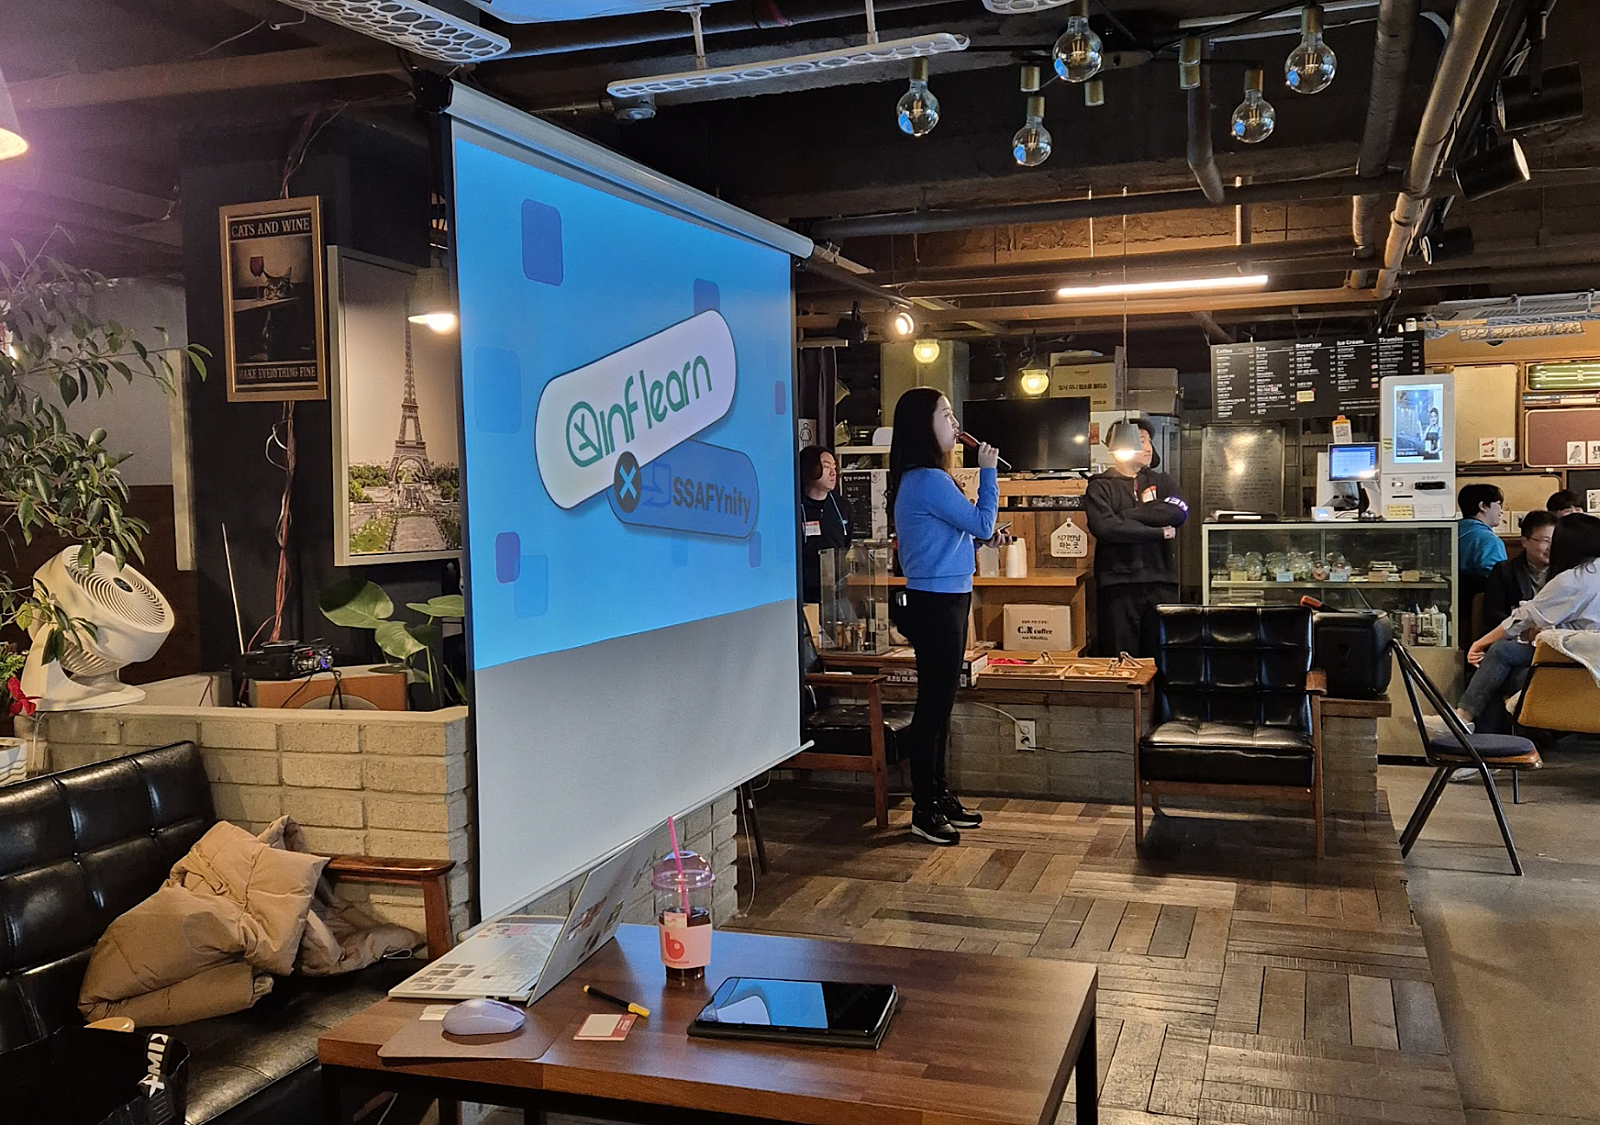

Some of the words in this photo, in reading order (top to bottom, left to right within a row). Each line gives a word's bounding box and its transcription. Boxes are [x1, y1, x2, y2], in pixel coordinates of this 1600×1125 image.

[231, 223, 255, 237] CATS
[257, 221, 279, 235] AND
[281, 217, 310, 232] WINE
[238, 368, 257, 380] MAKE
[258, 367, 298, 379] EVERYTHING
[299, 366, 316, 377] FINE
[599, 355, 713, 456] inflearn
[619, 464, 637, 500] X
[672, 475, 751, 524] SSAFYnity
[1056, 534, 1082, 542] 식기반납
[1058, 541, 1071, 550] 하는
[1072, 541, 1079, 550] 곳
